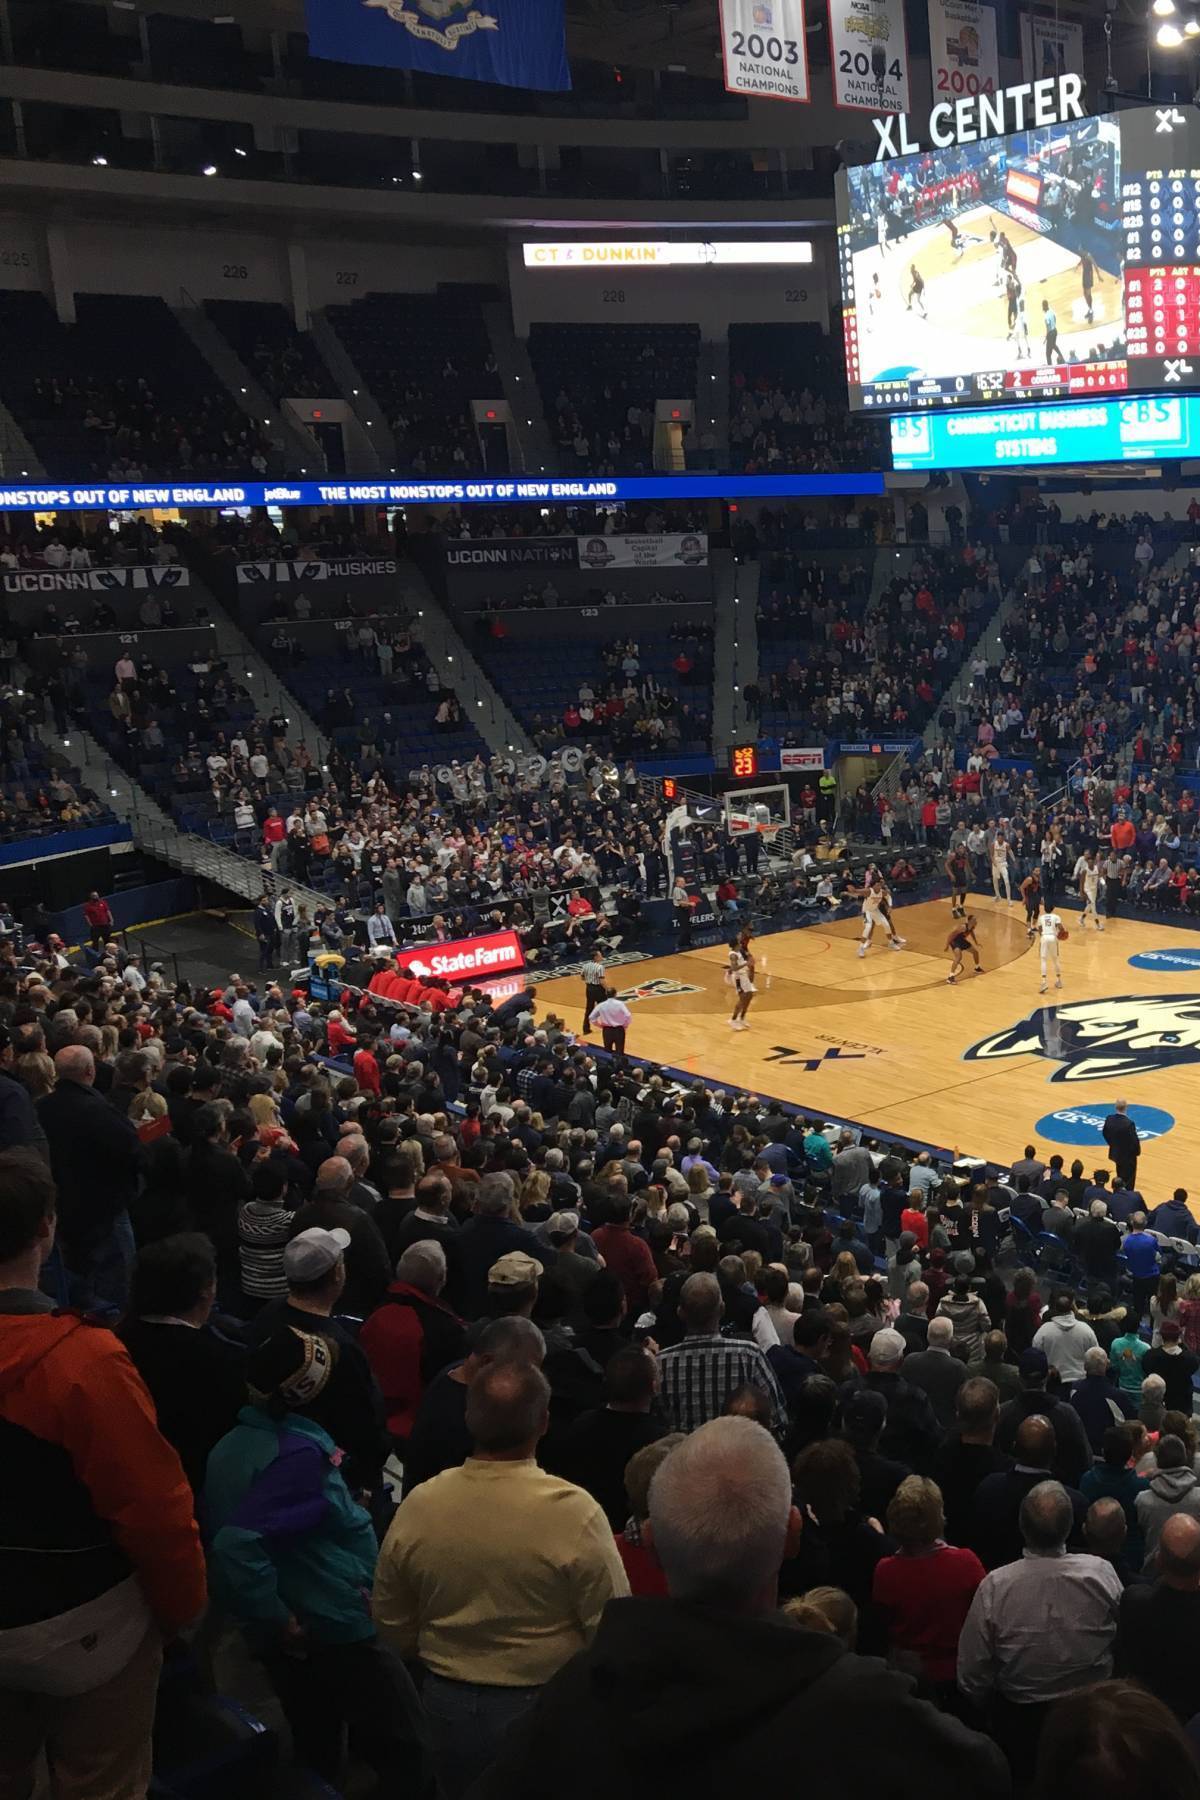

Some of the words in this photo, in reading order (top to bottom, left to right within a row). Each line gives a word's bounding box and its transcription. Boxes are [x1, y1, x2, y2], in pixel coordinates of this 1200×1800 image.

[731, 31, 799, 64] 2003
[739, 62, 793, 80] NATIONAL
[735, 76, 799, 96] CHAMPIONS
[937, 68, 994, 96] 2004
[844, 93, 903, 110] CHAMPIONS
[872, 113, 920, 161] XL
[929, 73, 1086, 148] CENTER
[1155, 108, 1186, 133] XL
[1168, 169, 1187, 178] AST
[534, 249, 558, 261] CT
[1013, 371, 1022, 387] 2
[1163, 358, 1194, 382] XL
[995, 437, 1058, 459] SYSTEMS
[73, 490, 106, 504] OUT
[108, 489, 130, 503] OF
[133, 488, 170, 503] NEW
[173, 487, 245, 503] ENGLAND
[264, 488, 301, 501] jetBlue
[318, 486, 347, 500] THE
[349, 486, 387, 500] MOST
[389, 484, 463, 499] NONSTOPS
[466, 484, 495, 498] OUT
[497, 484, 515, 497] OF
[517, 483, 549, 497] NEW
[551, 482, 617, 497] ENGLAND
[447, 549, 507, 564] UCONN
[326, 561, 398, 577] HUSKIES
[4, 572, 92, 593] UCONN
[580, 608, 599, 617] 123
[734, 758, 753, 776] 23
[782, 753, 823, 766] ESPN
[431, 944, 516, 976] StateFarm
